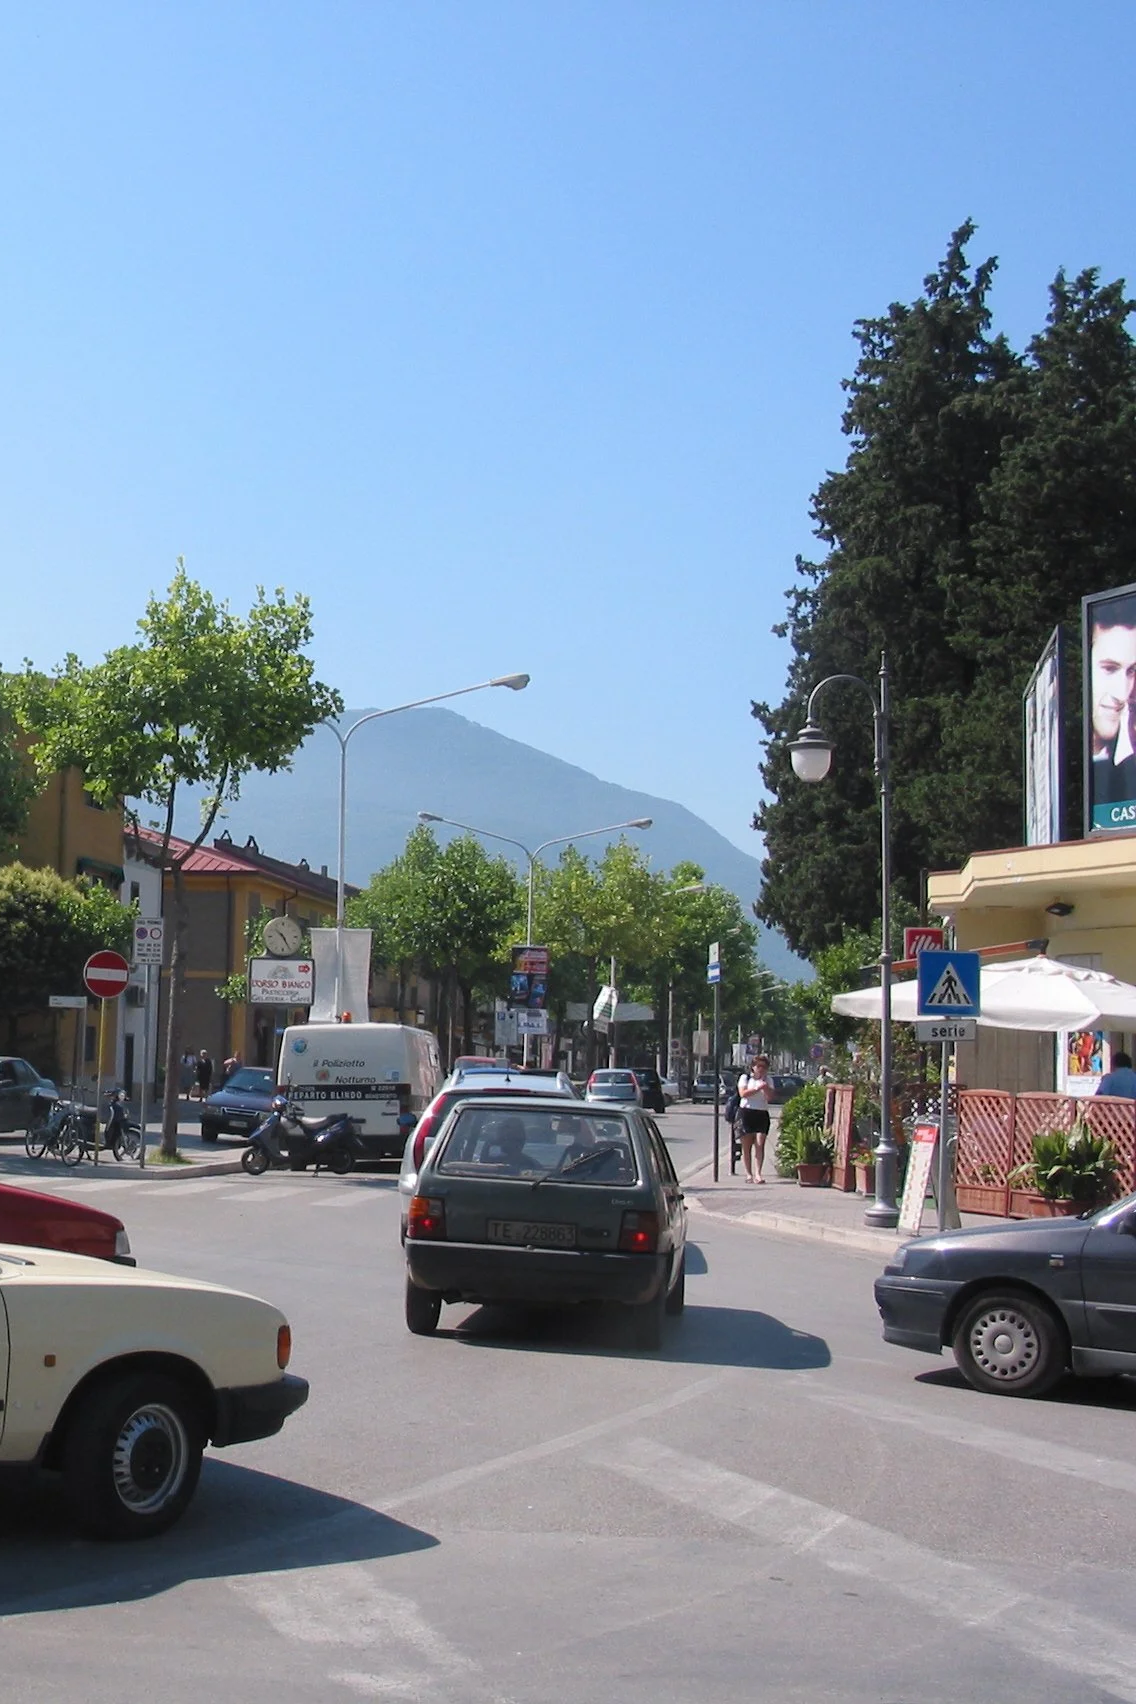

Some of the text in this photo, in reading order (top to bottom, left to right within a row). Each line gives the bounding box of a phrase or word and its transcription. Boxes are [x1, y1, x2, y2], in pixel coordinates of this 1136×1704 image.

[931, 1024, 966, 1038] serie
[321, 1060, 366, 1068] Poliziotto
[335, 1075, 376, 1084] Notturno
[330, 1091, 363, 1100] BLINDO
